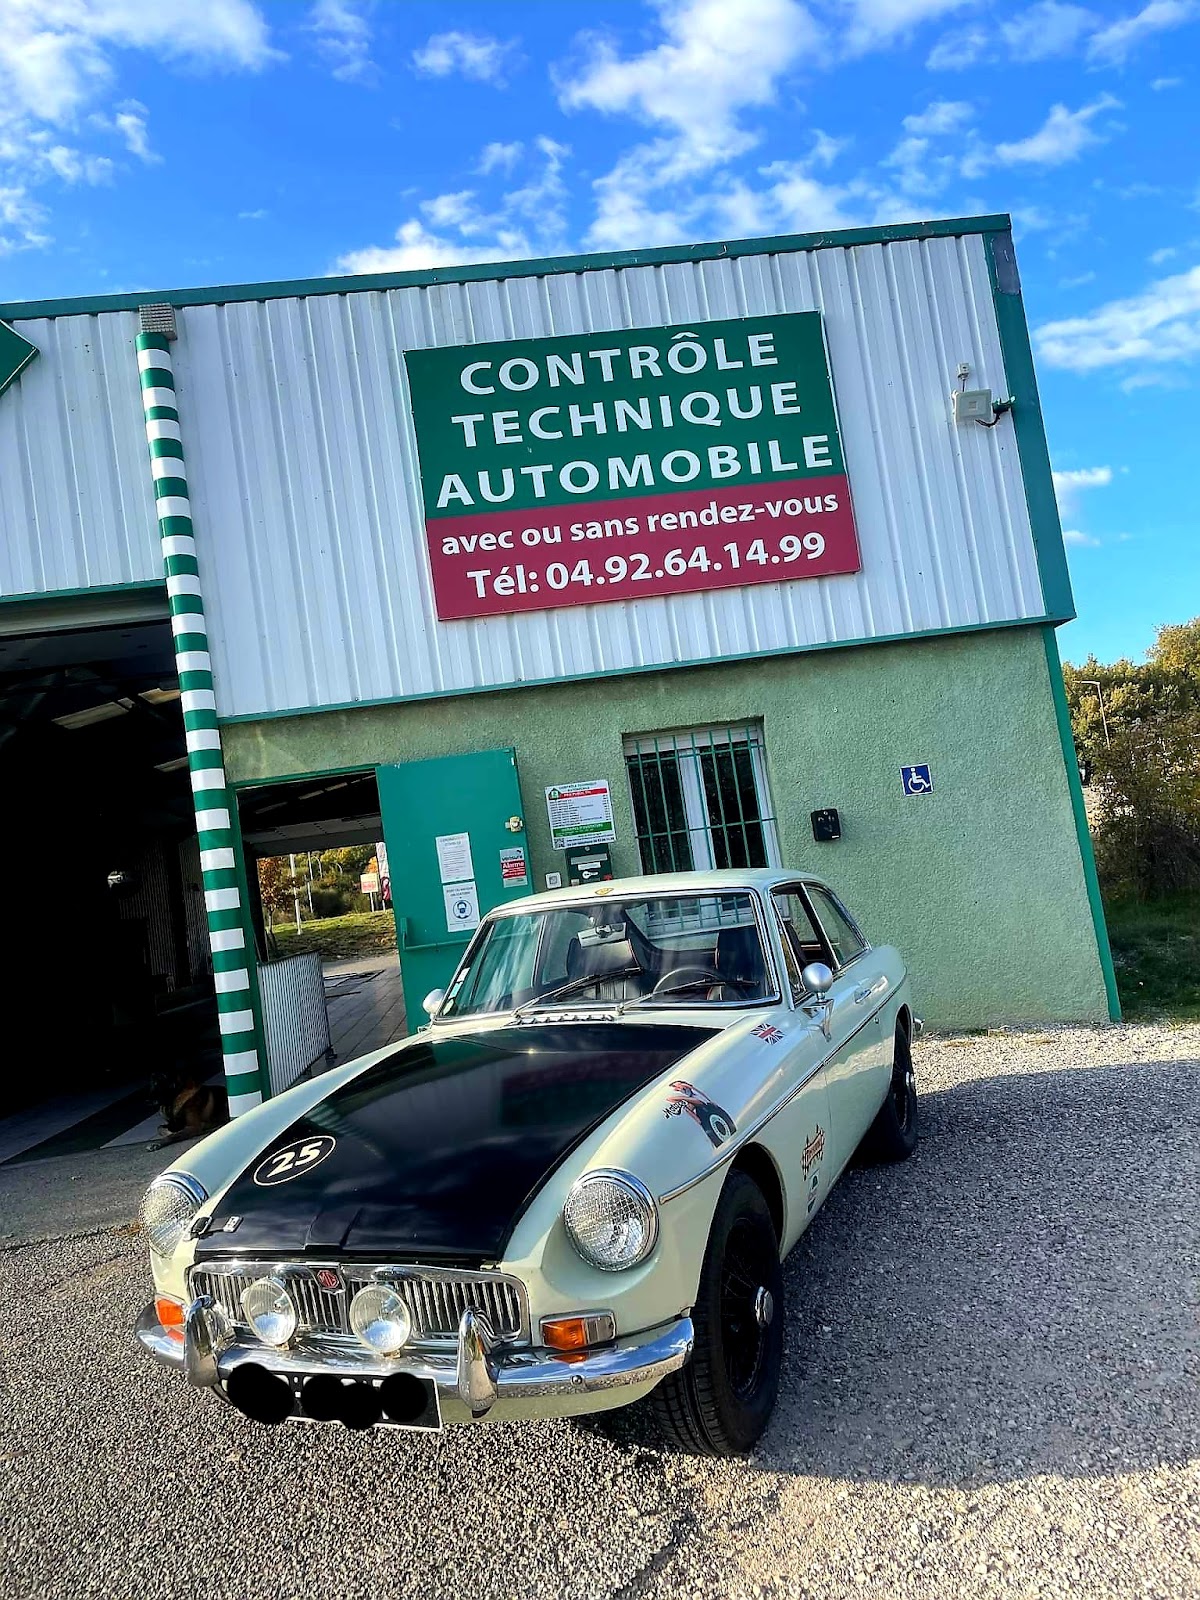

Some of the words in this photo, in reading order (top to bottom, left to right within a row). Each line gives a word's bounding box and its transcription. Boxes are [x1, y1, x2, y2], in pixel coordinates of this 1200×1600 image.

[460, 331, 779, 396] CONTRÔLE
[451, 381, 802, 448] TECHNIQUE
[436, 434, 833, 508] AUTOMOBILE
[441, 525, 514, 555] avec
[521, 523, 563, 547] ou
[570, 516, 640, 541] sans
[647, 493, 839, 532] rendez-vous
[467, 562, 540, 599] Tél:
[545, 531, 826, 590] 04.92.64.14.99
[266, 1141, 323, 1178] 25
